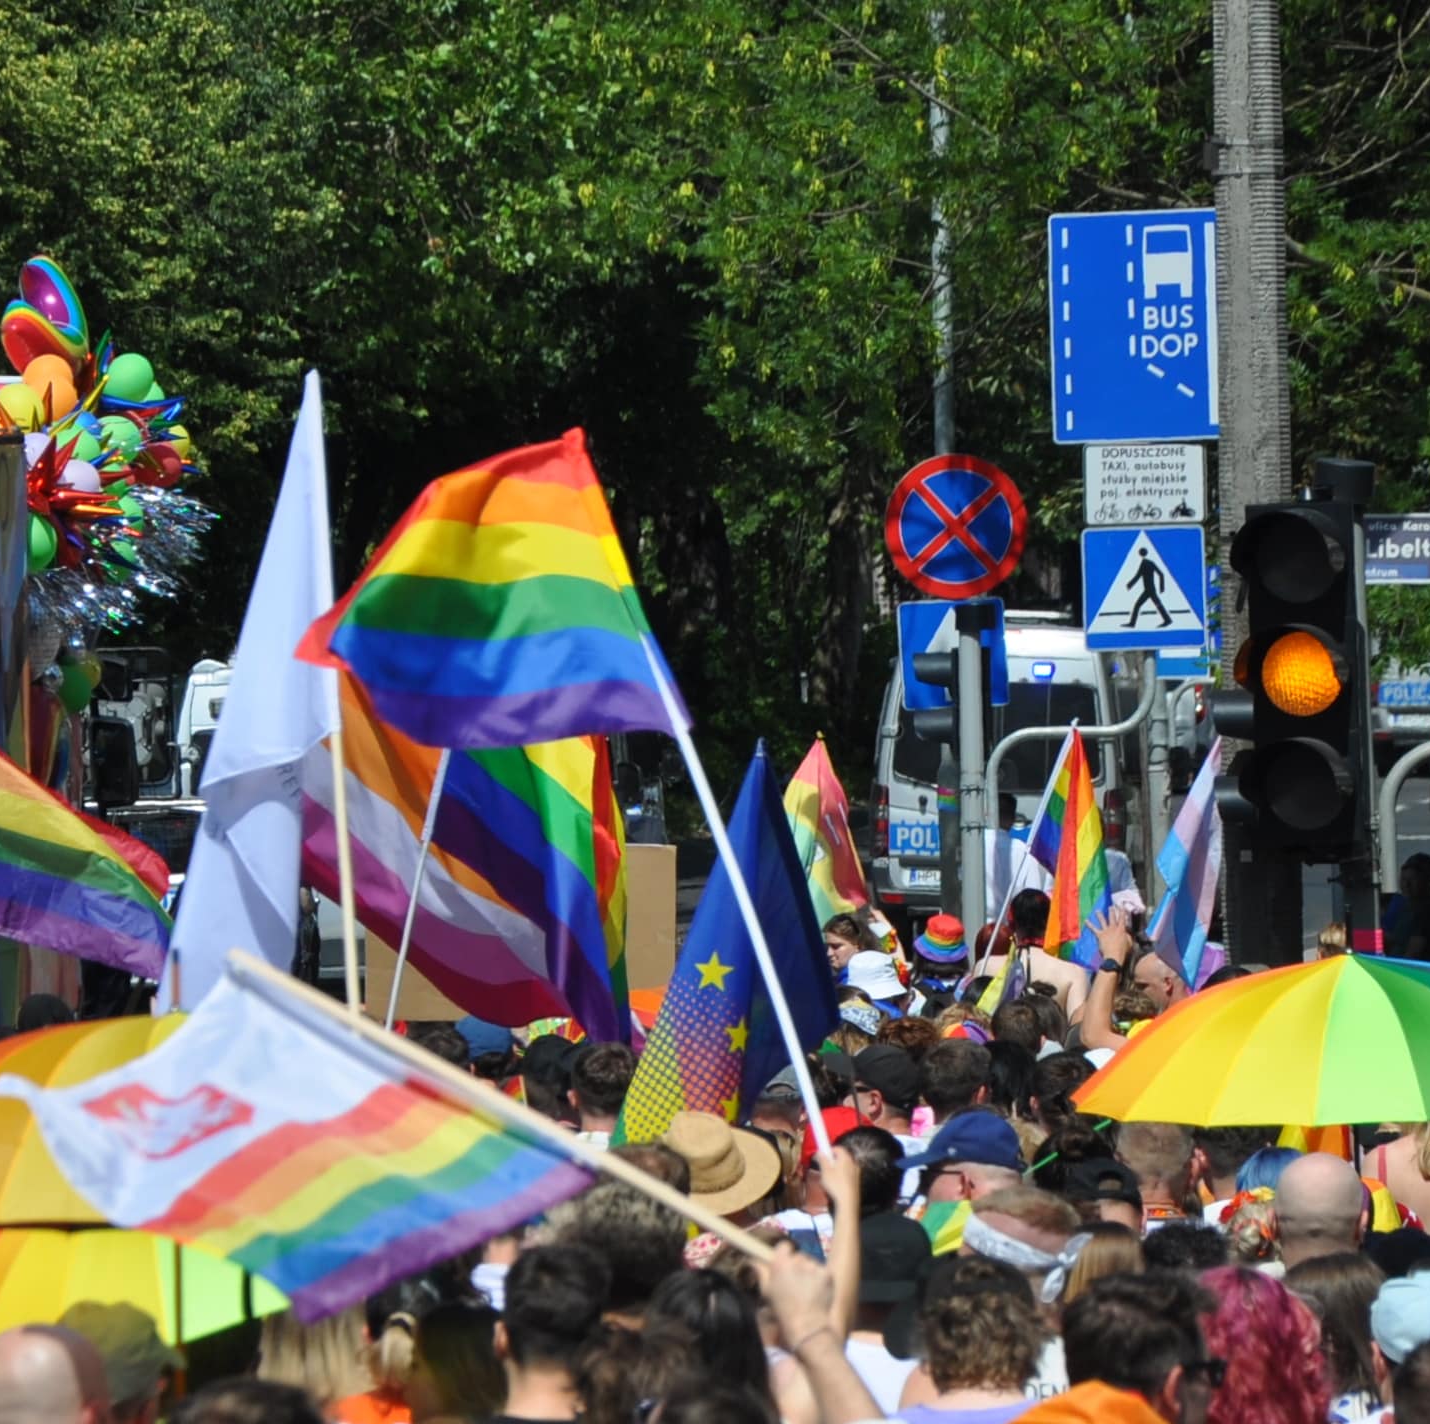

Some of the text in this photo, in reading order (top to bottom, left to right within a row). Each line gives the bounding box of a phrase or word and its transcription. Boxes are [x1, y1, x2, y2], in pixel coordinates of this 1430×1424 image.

[1143, 304, 1194, 330] BUS
[1141, 332, 1199, 359] DOP
[1101, 447, 1186, 458] DOPUSZCZONE
[1134, 461, 1187, 472] autobusy
[1141, 474, 1188, 486] miejskie
[1125, 488, 1189, 498] elektryczne
